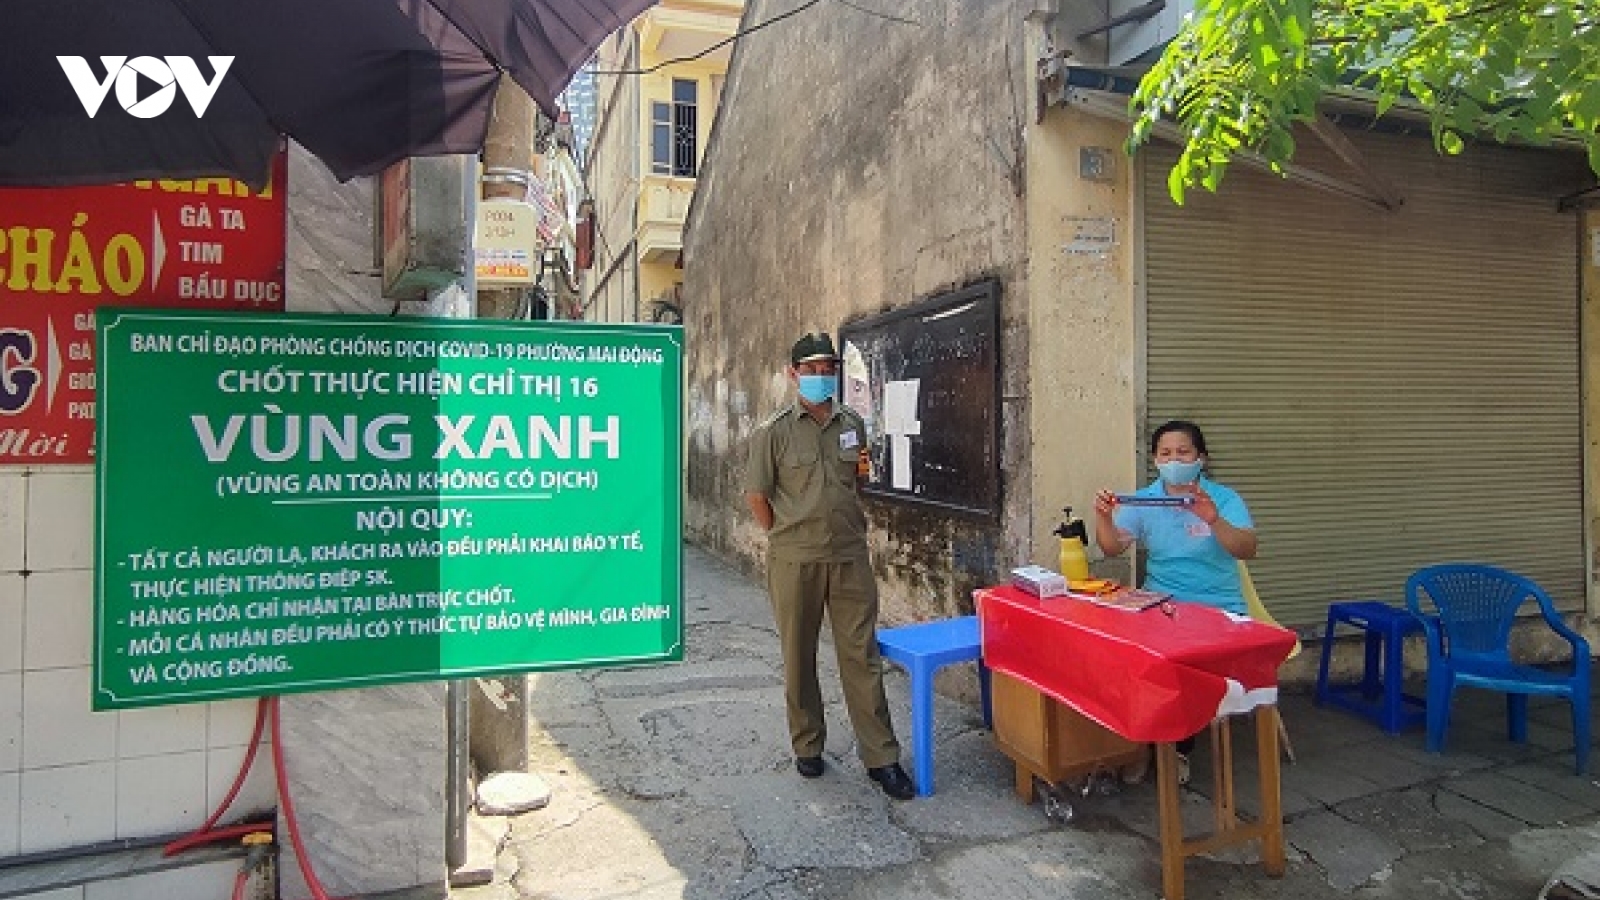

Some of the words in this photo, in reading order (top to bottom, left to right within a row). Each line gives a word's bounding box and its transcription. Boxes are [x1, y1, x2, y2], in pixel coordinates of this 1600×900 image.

[180, 202, 212, 229] GÀ
[219, 208, 246, 230] TA
[0, 212, 145, 296] HÁO
[179, 241, 223, 264] TIM
[234, 279, 280, 306] DỤC
[130, 333, 172, 352] BAN
[176, 330, 209, 352] CHỈ
[213, 335, 257, 358] ĐẠO
[260, 334, 326, 355] PHÒNG
[329, 333, 391, 357] CHỐNG
[397, 340, 436, 362] DỊCH
[439, 341, 513, 360] COVID-19
[516, 341, 585, 363] PHƯỜNG
[588, 345, 618, 363] MAI
[620, 345, 664, 368] ĐỘNG
[217, 362, 304, 393] CHỐT
[308, 368, 390, 400] THỰC
[397, 367, 462, 400] HIỆN
[468, 367, 515, 396] CHỈ
[520, 374, 561, 402] THỊ
[570, 376, 599, 398] 16
[190, 403, 412, 462] VÙNG
[432, 415, 620, 459] XANH
[216, 471, 300, 498] (VÙNG
[306, 473, 341, 492] AN
[346, 468, 411, 491] TOÀN
[417, 468, 500, 490] KHÔNG
[504, 466, 534, 489] CÓ
[540, 469, 599, 493] DỊCH)
[356, 506, 402, 536] NỘI
[411, 508, 473, 531] QUY:
[128, 546, 170, 571] TẤT
[173, 546, 202, 568] CẢ
[207, 546, 272, 567] NGƯỜI
[277, 547, 306, 568] LẠ,
[311, 541, 374, 561] KHÁCH
[379, 542, 403, 559] RA
[408, 537, 443, 557] VÀO
[447, 535, 482, 556] ĐỀU
[487, 533, 525, 554] PHẢI
[530, 536, 568, 554] KHAI
[573, 532, 606, 552] BÁO
[607, 535, 619, 550] Y
[621, 530, 644, 551] TẾ,
[130, 578, 190, 602] THỰC
[194, 575, 241, 598] HIỆN
[245, 569, 315, 590] THÔNG
[319, 567, 360, 591] ĐIỆP
[365, 569, 393, 585] 5K.
[129, 605, 191, 628] HÀNG
[196, 602, 240, 622] HÓA
[245, 596, 279, 619] CHỈ
[282, 596, 338, 619] NHẬN
[341, 596, 371, 616] TẠI
[375, 592, 412, 611] BÀN
[416, 587, 462, 611] TRỰC
[466, 583, 516, 606] CHỐT.
[128, 630, 171, 656] MỖI
[175, 630, 204, 652] CÁ
[210, 625, 267, 650] NHÂN
[271, 623, 312, 646] ĐỀU
[315, 618, 361, 642] PHẢI
[364, 618, 390, 638] CÓ
[392, 618, 404, 636] Ý
[408, 614, 456, 636] THỨC
[457, 613, 484, 635] TỰ
[485, 610, 521, 631] BẢO
[524, 609, 546, 633] VỆ
[549, 608, 596, 628] MÌNH,
[600, 607, 628, 623] GIA
[631, 602, 671, 622] ĐÌNH
[129, 664, 158, 685] VÀ
[162, 659, 222, 686] CỘNG
[227, 652, 293, 675] ĐỒNG.
